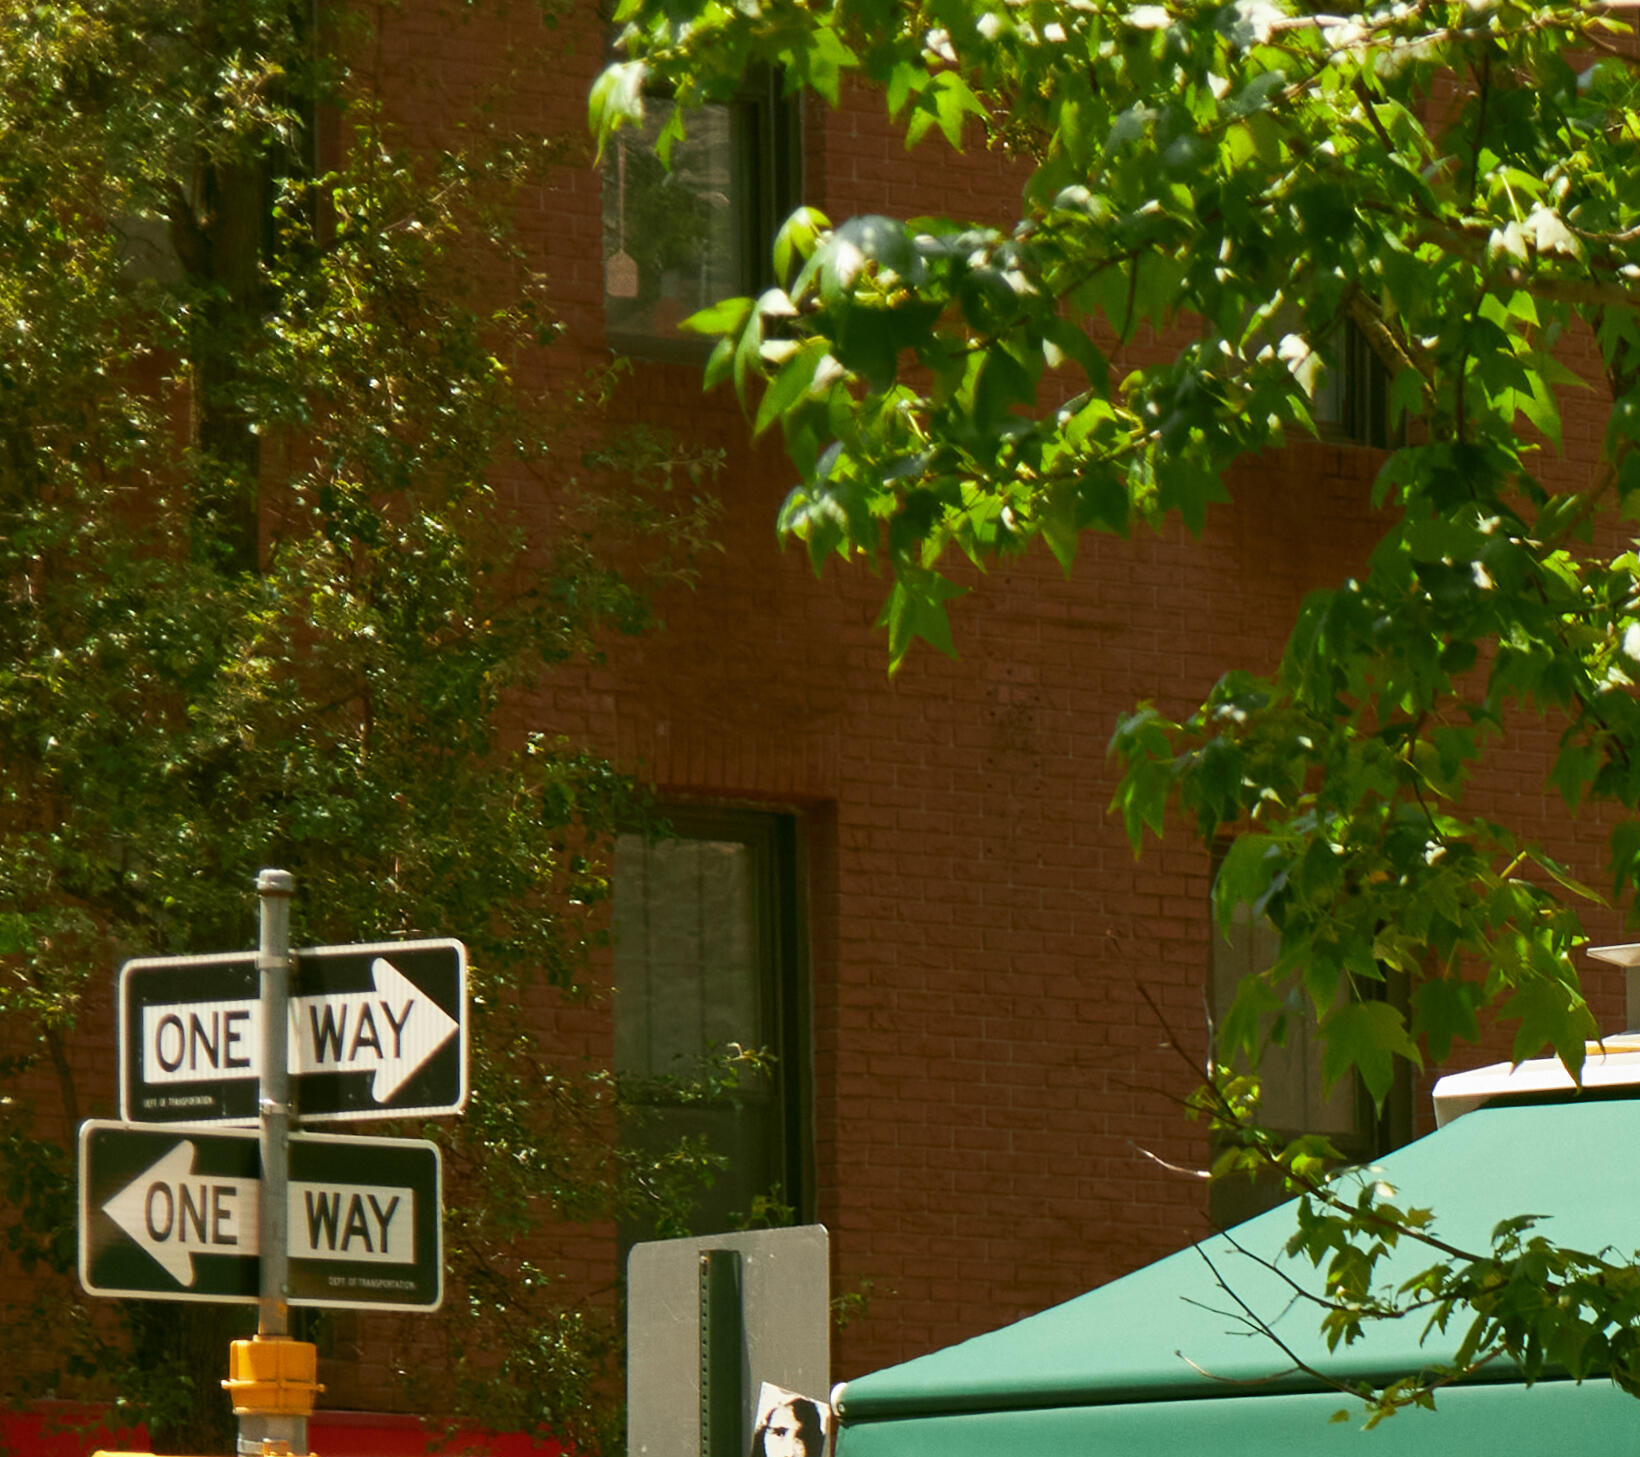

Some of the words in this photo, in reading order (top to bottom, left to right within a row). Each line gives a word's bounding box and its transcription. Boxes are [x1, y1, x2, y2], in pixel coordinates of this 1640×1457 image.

[155, 1010, 250, 1073] ONE
[309, 999, 414, 1063] WAY
[144, 1180, 238, 1245] ONE
[305, 1190, 400, 1253] WAY
